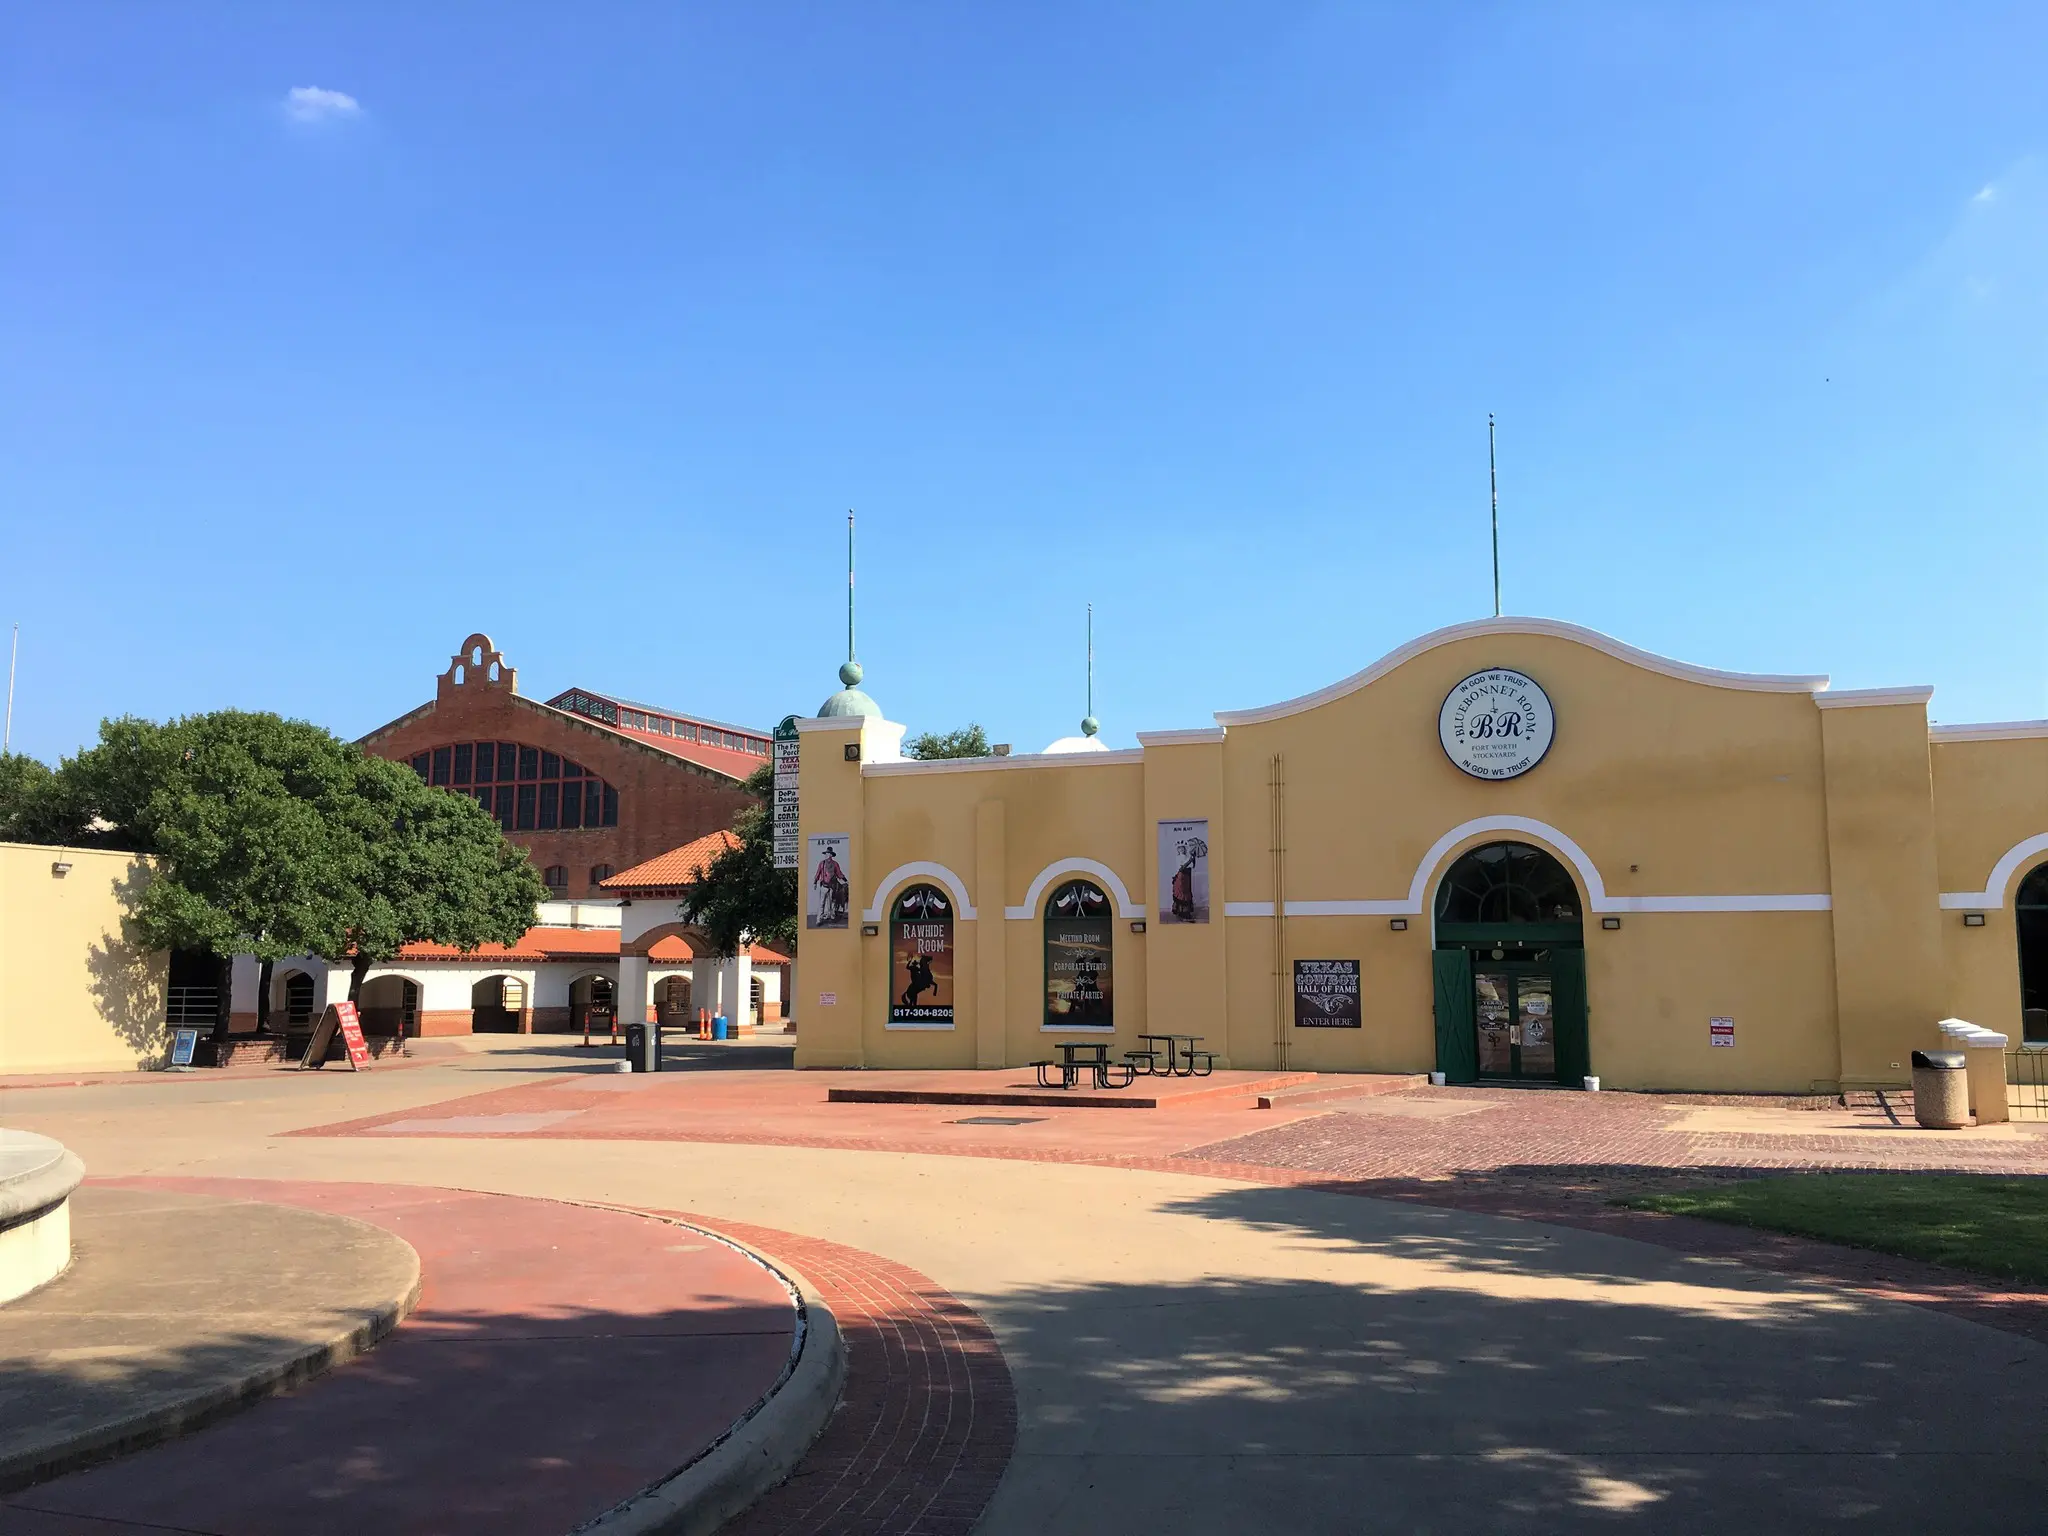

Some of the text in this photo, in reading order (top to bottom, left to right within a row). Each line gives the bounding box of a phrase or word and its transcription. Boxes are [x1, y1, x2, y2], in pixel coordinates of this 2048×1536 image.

[1460, 684, 1469, 693] IN
[1469, 676, 1486, 687] GOD
[1503, 674, 1528, 688] TRUST
[1454, 685, 1537, 737] BLUEBONNET ROOM
[777, 743, 789, 751] The
[1471, 743, 1518, 752] FORT WORTH
[1472, 751, 1517, 760] STOCKYARDS
[1462, 759, 1471, 768] IN
[1471, 764, 1489, 775] GOD
[1506, 756, 1531, 774] TRUST
[903, 923, 945, 939] RAWHIDE
[1083, 933, 1100, 943] ROOM
[917, 938, 945, 954] ROOM
[1053, 962, 1107, 972] CORPORATE EVENTS
[1300, 962, 1353, 974] TEXAS
[1295, 974, 1359, 985] COWBOY
[1297, 985, 1358, 993] HALL OF FAME
[1056, 990, 1104, 1000] PRIVATE PARTIES
[893, 1008, 954, 1018] 817-304-8205
[1303, 1017, 1353, 1026] ENTER HERE
